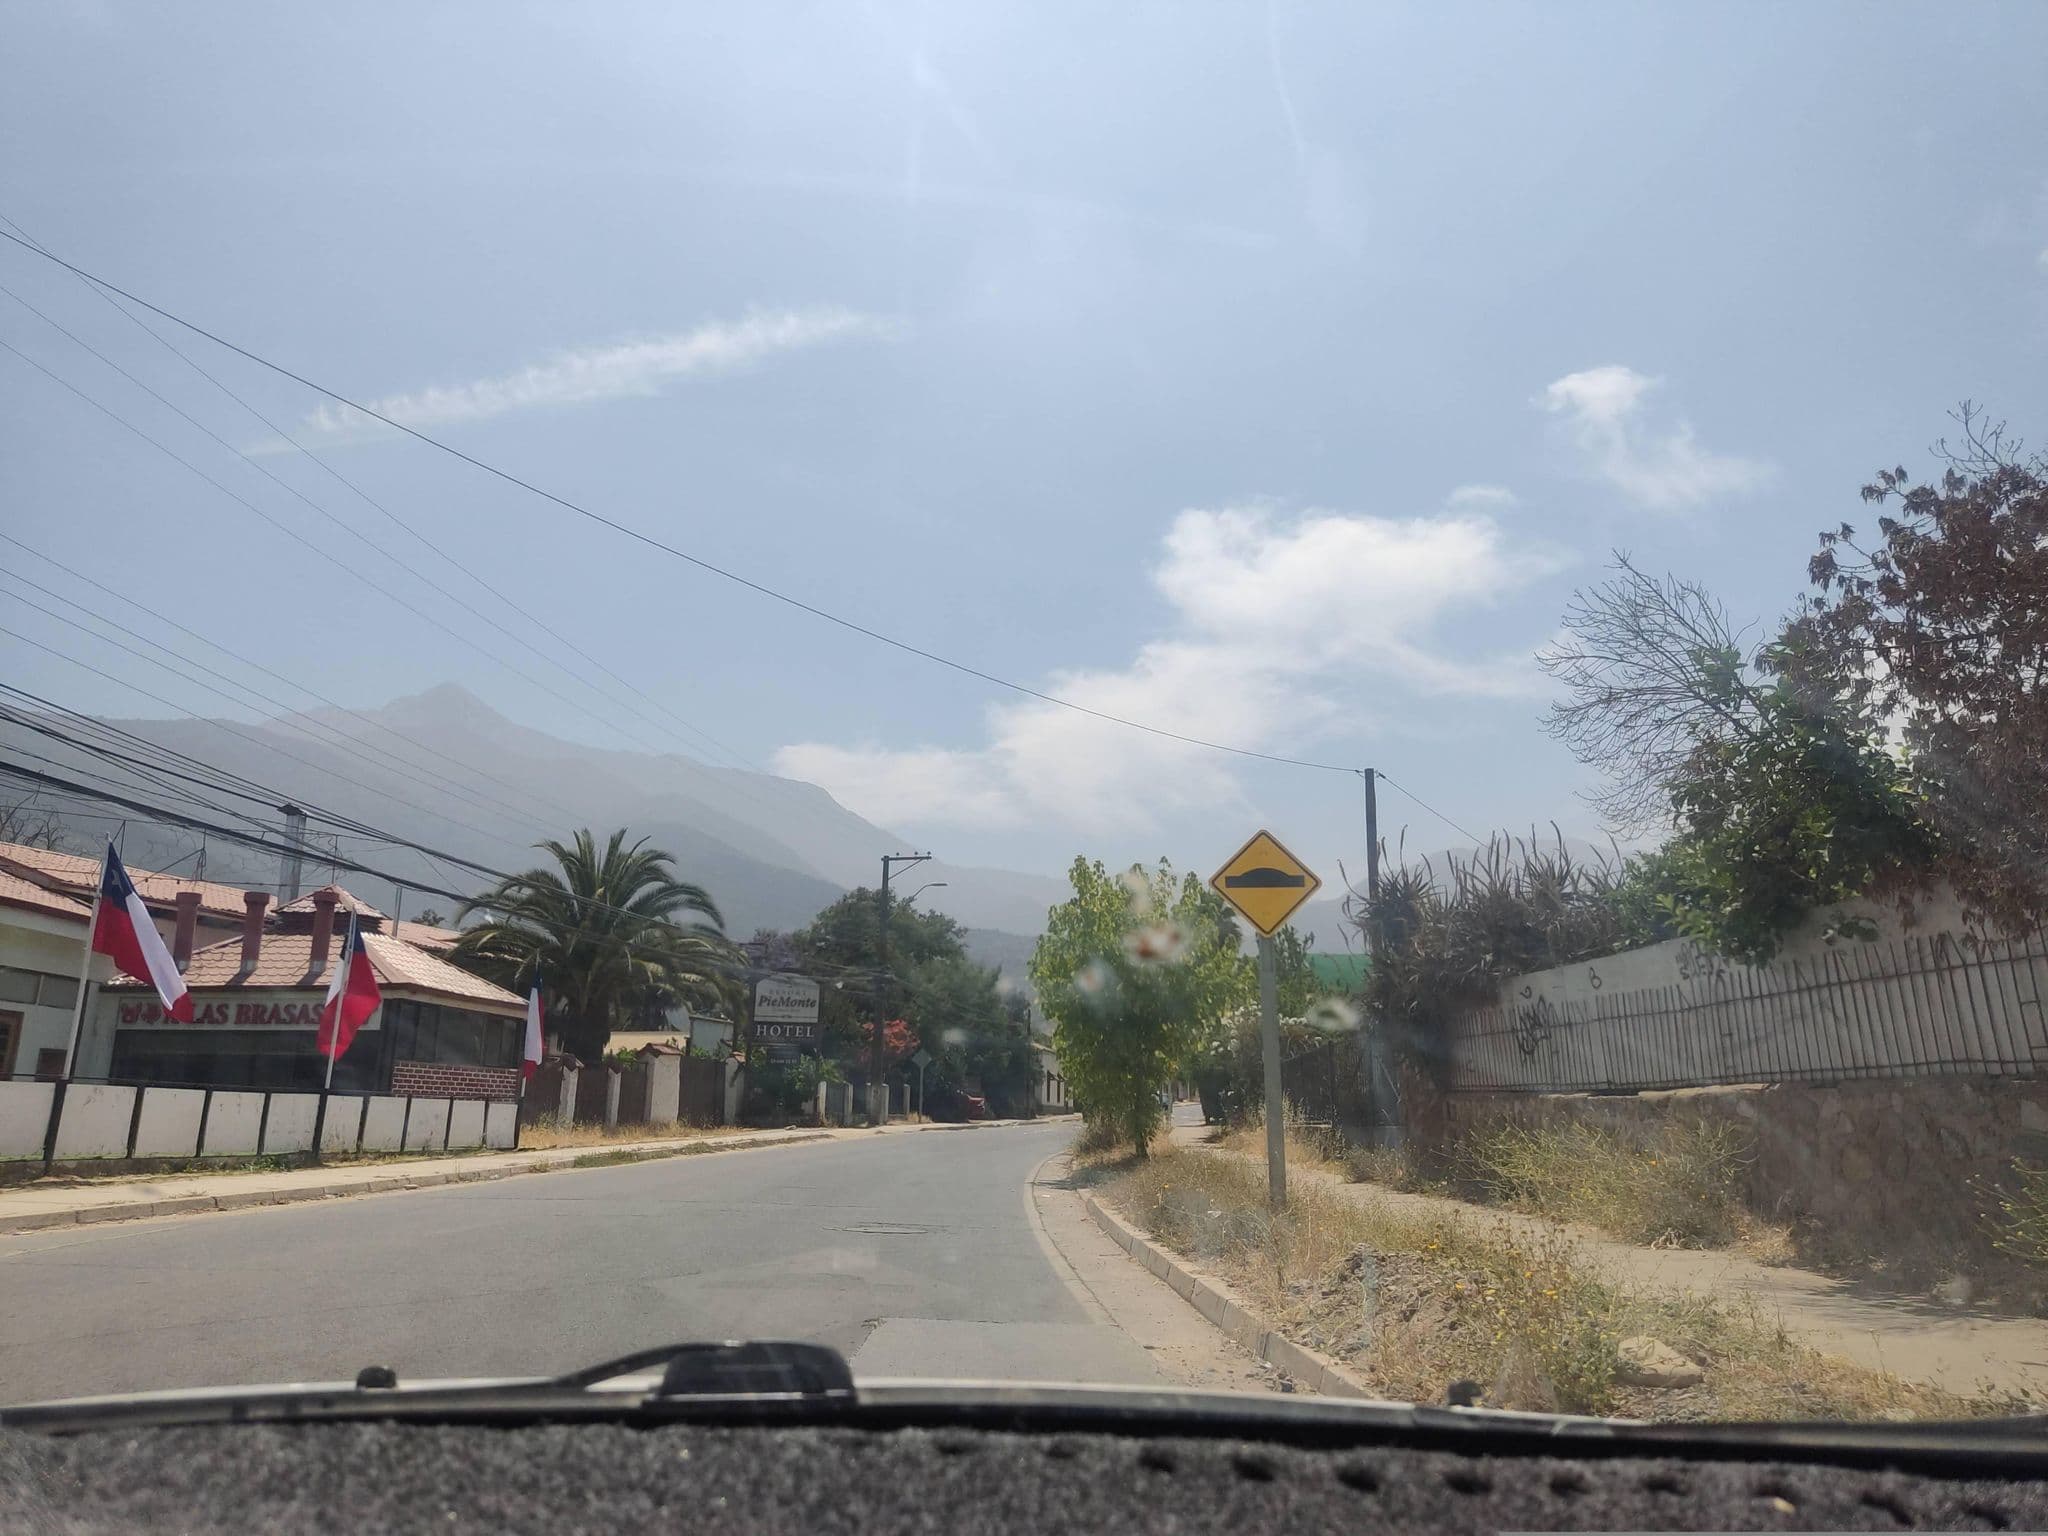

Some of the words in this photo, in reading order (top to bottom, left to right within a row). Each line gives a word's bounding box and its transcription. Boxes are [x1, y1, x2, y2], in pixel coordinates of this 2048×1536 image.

[758, 995, 817, 1008] PieMonte
[234, 1003, 325, 1025] BRASAS
[756, 1024, 815, 1038] HOTEL
